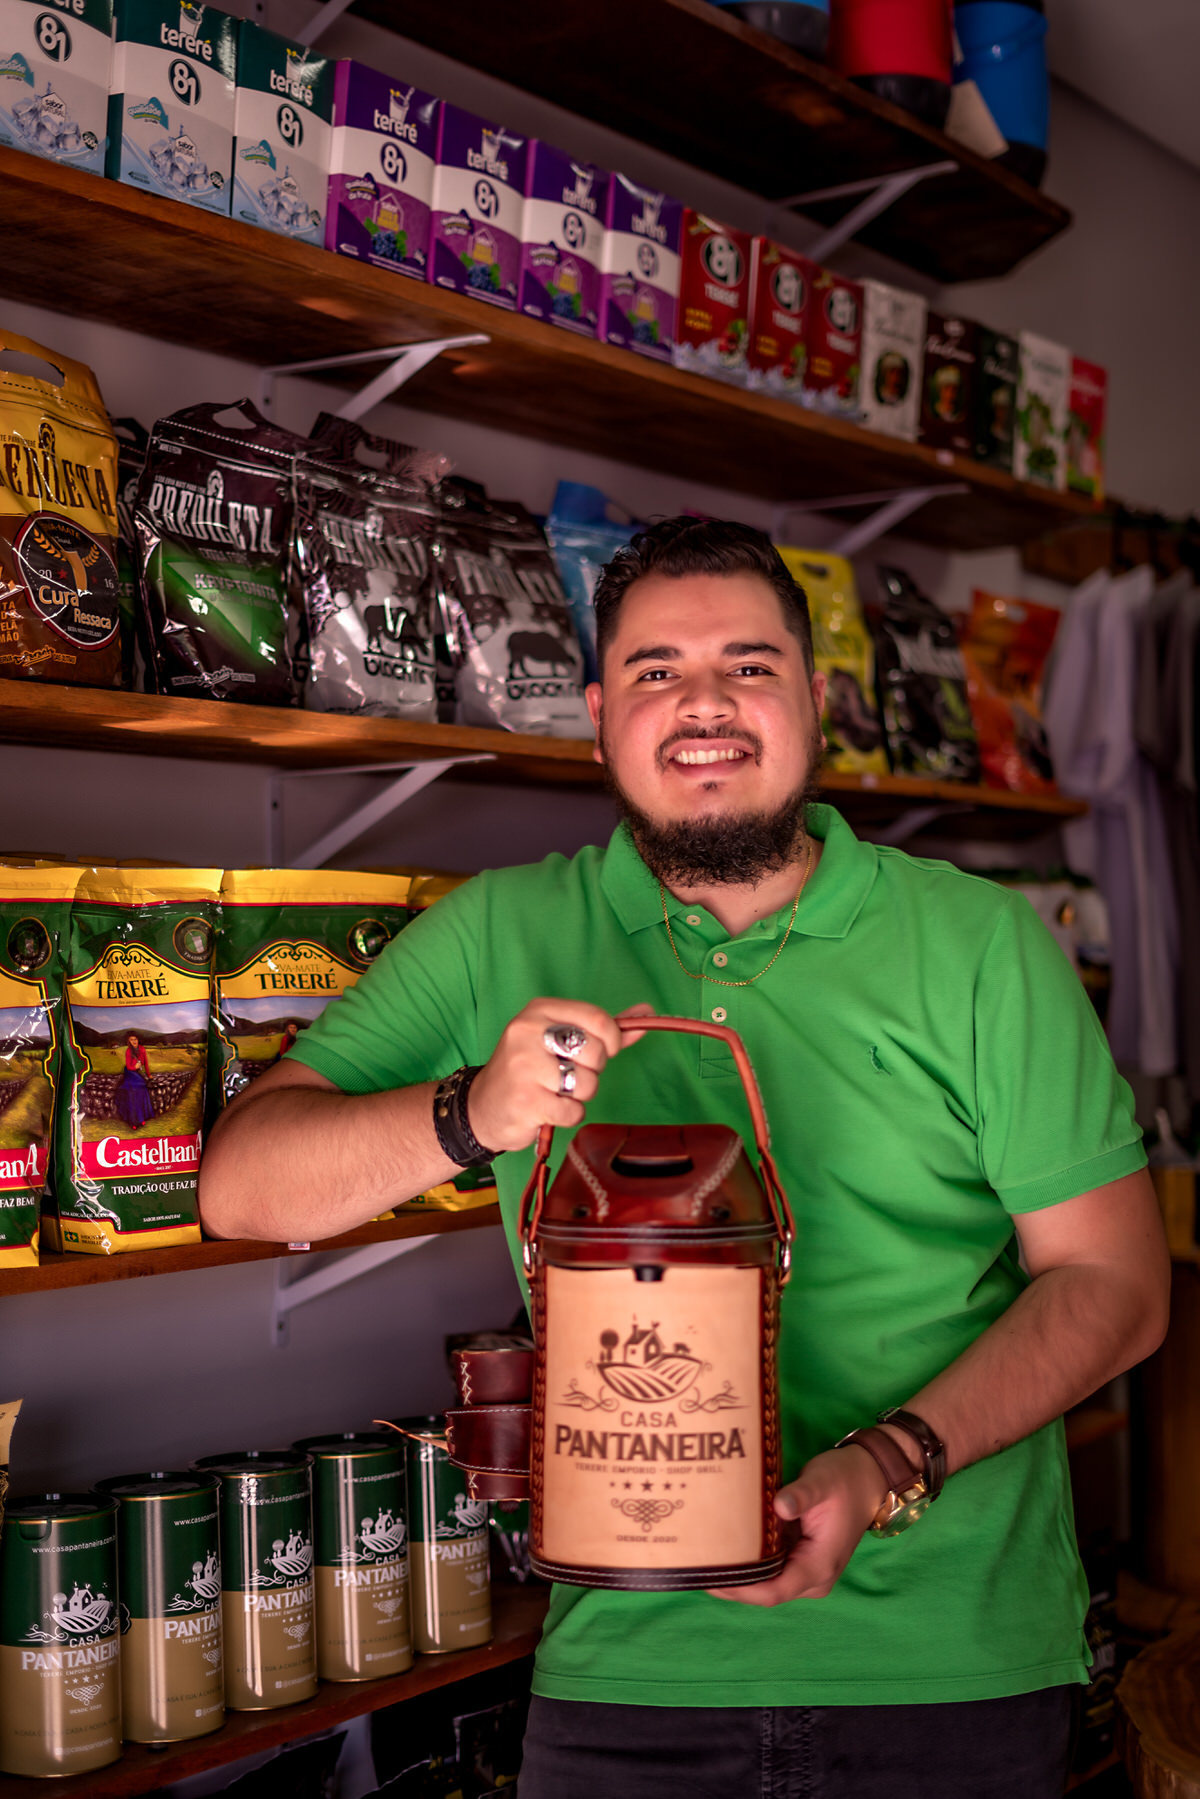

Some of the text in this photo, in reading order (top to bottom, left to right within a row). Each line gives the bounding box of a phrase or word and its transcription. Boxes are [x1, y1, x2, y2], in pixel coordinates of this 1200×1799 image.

[40, 16, 66, 62] 81
[160, 23, 213, 61] tereré
[173, 62, 196, 105] 81
[270, 69, 313, 106] tereré
[280, 108, 299, 147] 81
[374, 109, 418, 144] tereré
[383, 145, 404, 185] 81
[467, 147, 509, 181] tereré
[477, 179, 497, 220] 81
[709, 236, 739, 287] 81
[774, 264, 802, 314] 81
[829, 288, 858, 336] 81
[148, 482, 280, 553] PREDILETA
[39, 569, 52, 579] 20
[105, 578, 115, 589] 16
[39, 585, 80, 606] Cura
[74, 608, 111, 629] Ressaca
[107, 969, 151, 979] EVA-MATE
[254, 968, 338, 989] TERERÉ
[269, 963, 321, 973] VA-MATE
[96, 972, 168, 999] TERERÉ
[112, 1182, 158, 1195] TRADIÇÃO
[159, 1181, 175, 1193] QUE
[176, 1180, 190, 1190] FAZ
[620, 1411, 677, 1427] CASA
[555, 1424, 746, 1461] PANTANEIRA
[667, 1466, 692, 1474] SHOP
[696, 1465, 722, 1474] GRILL
[616, 1534, 649, 1542] DESDE
[376, 1553, 400, 1566] CASA
[286, 1576, 308, 1589] CASA
[69, 1634, 100, 1648] CASA
